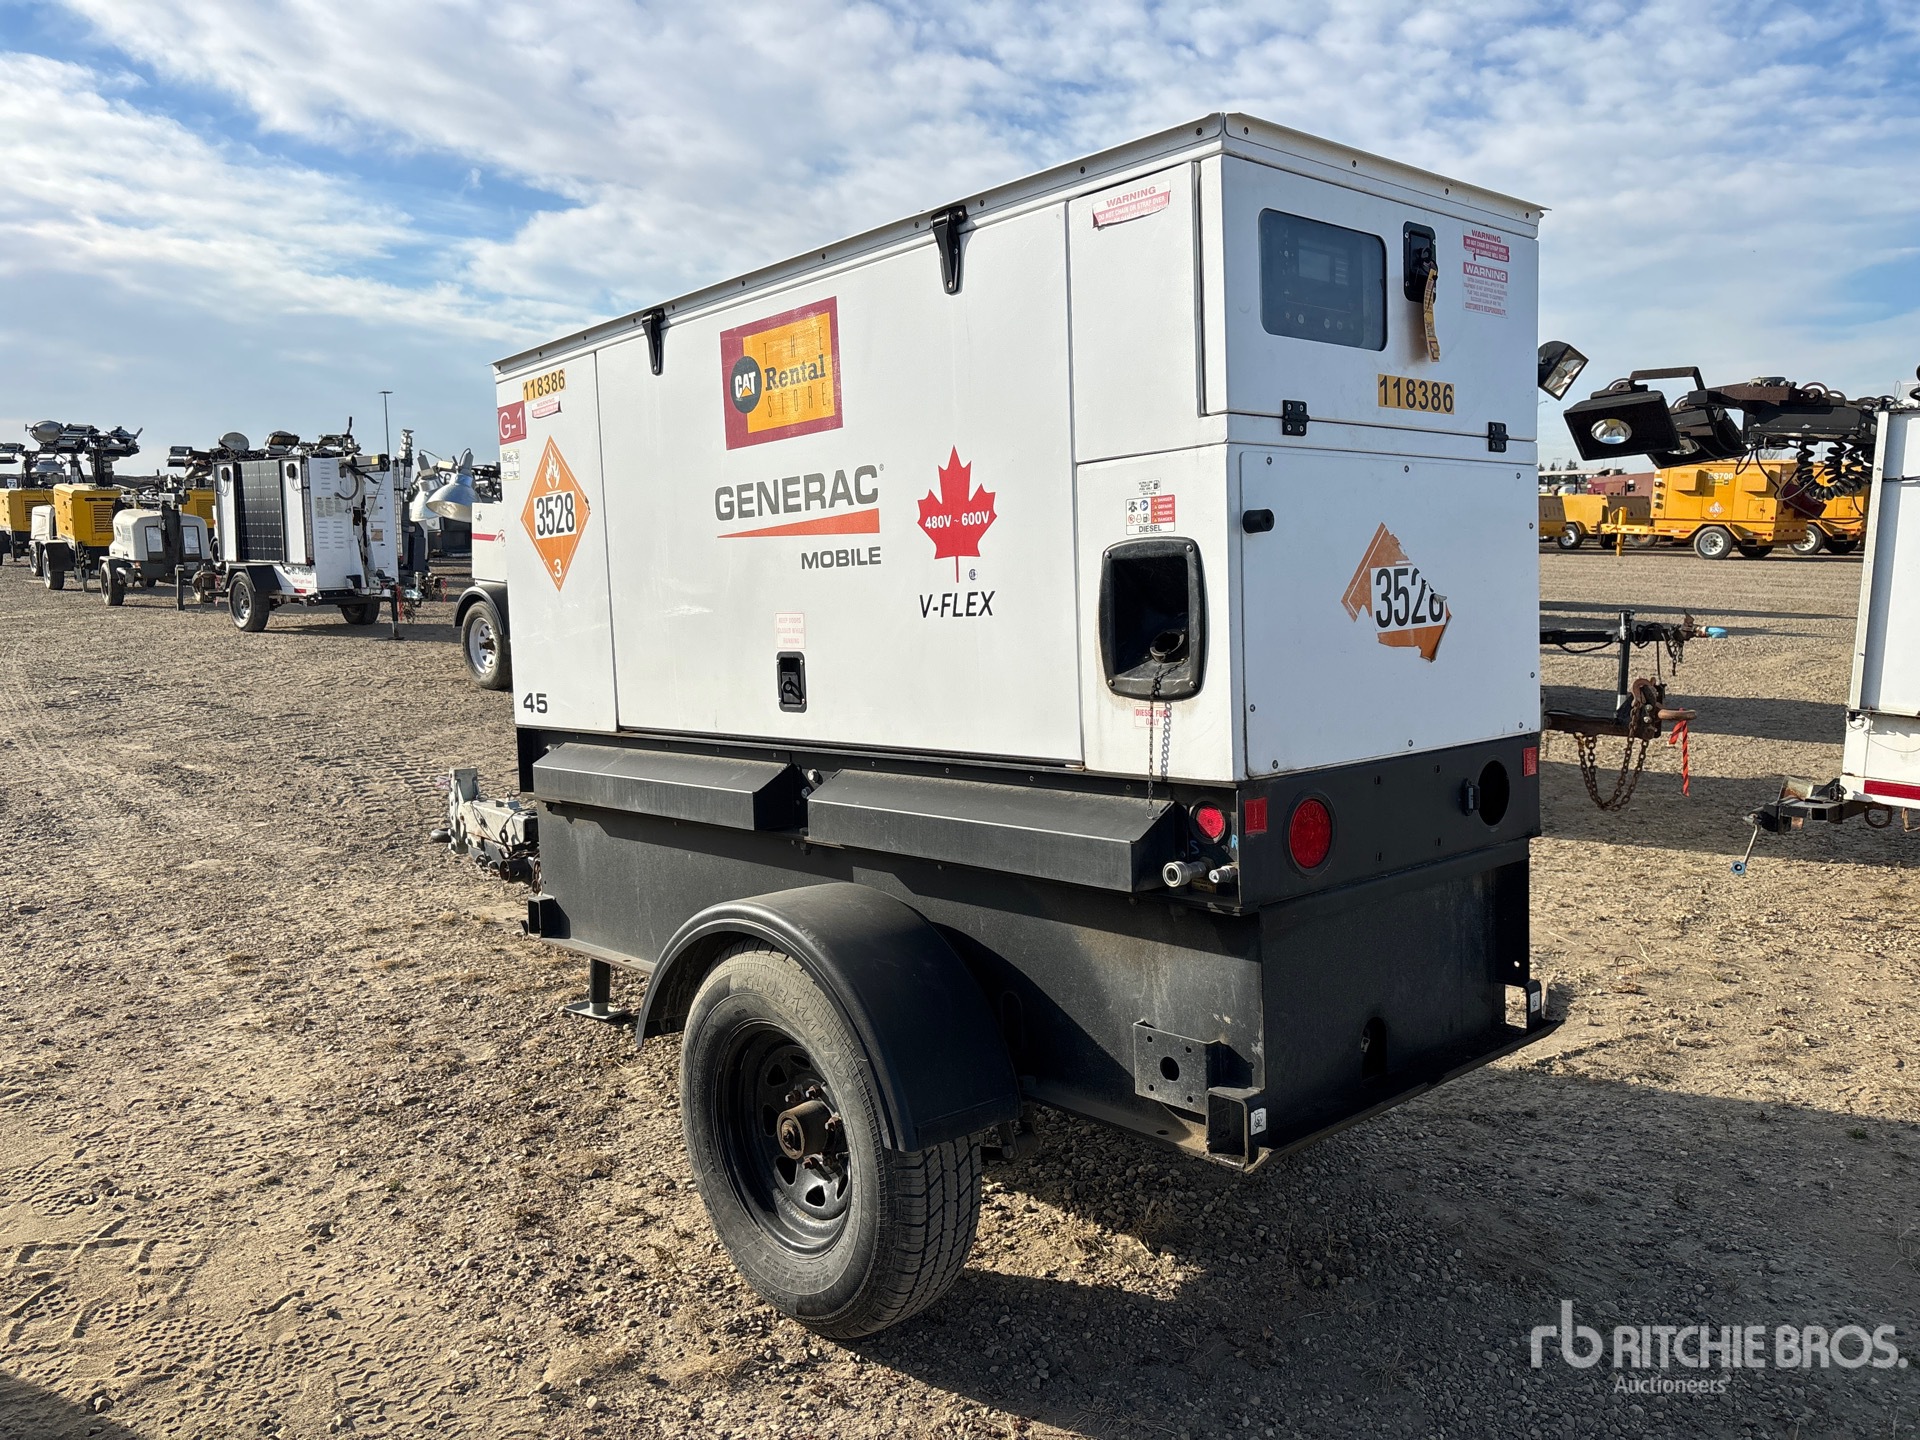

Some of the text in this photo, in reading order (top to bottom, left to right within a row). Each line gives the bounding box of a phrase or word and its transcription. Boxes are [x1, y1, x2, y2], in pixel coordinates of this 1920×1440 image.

[1106, 186, 1156, 208] WARNING
[1115, 207, 1129, 216] CHAIN
[1137, 200, 1152, 210] STRAP
[1152, 196, 1166, 205] OVER
[1472, 229, 1502, 244] WARNING
[1466, 263, 1507, 282] WARNING
[764, 326, 824, 365] THE
[764, 354, 826, 391] Rental
[524, 370, 565, 400] 118386
[734, 371, 756, 398] CAT
[1380, 376, 1454, 412] 118386
[768, 382, 826, 418] STORE
[500, 407, 524, 439] G-1
[714, 464, 879, 521] GENERAC
[536, 492, 575, 536] 3528
[924, 514, 952, 529] 480V
[961, 510, 990, 526] 600V
[1138, 524, 1162, 532] DIESEL
[554, 558, 562, 578] 3
[800, 546, 882, 570] MOBILE
[919, 590, 996, 618] V-FLEX
[523, 692, 548, 714] 45
[1136, 708, 1154, 716] DIESE
[1146, 718, 1160, 726] OLY
[1190, 840, 1200, 854] S
